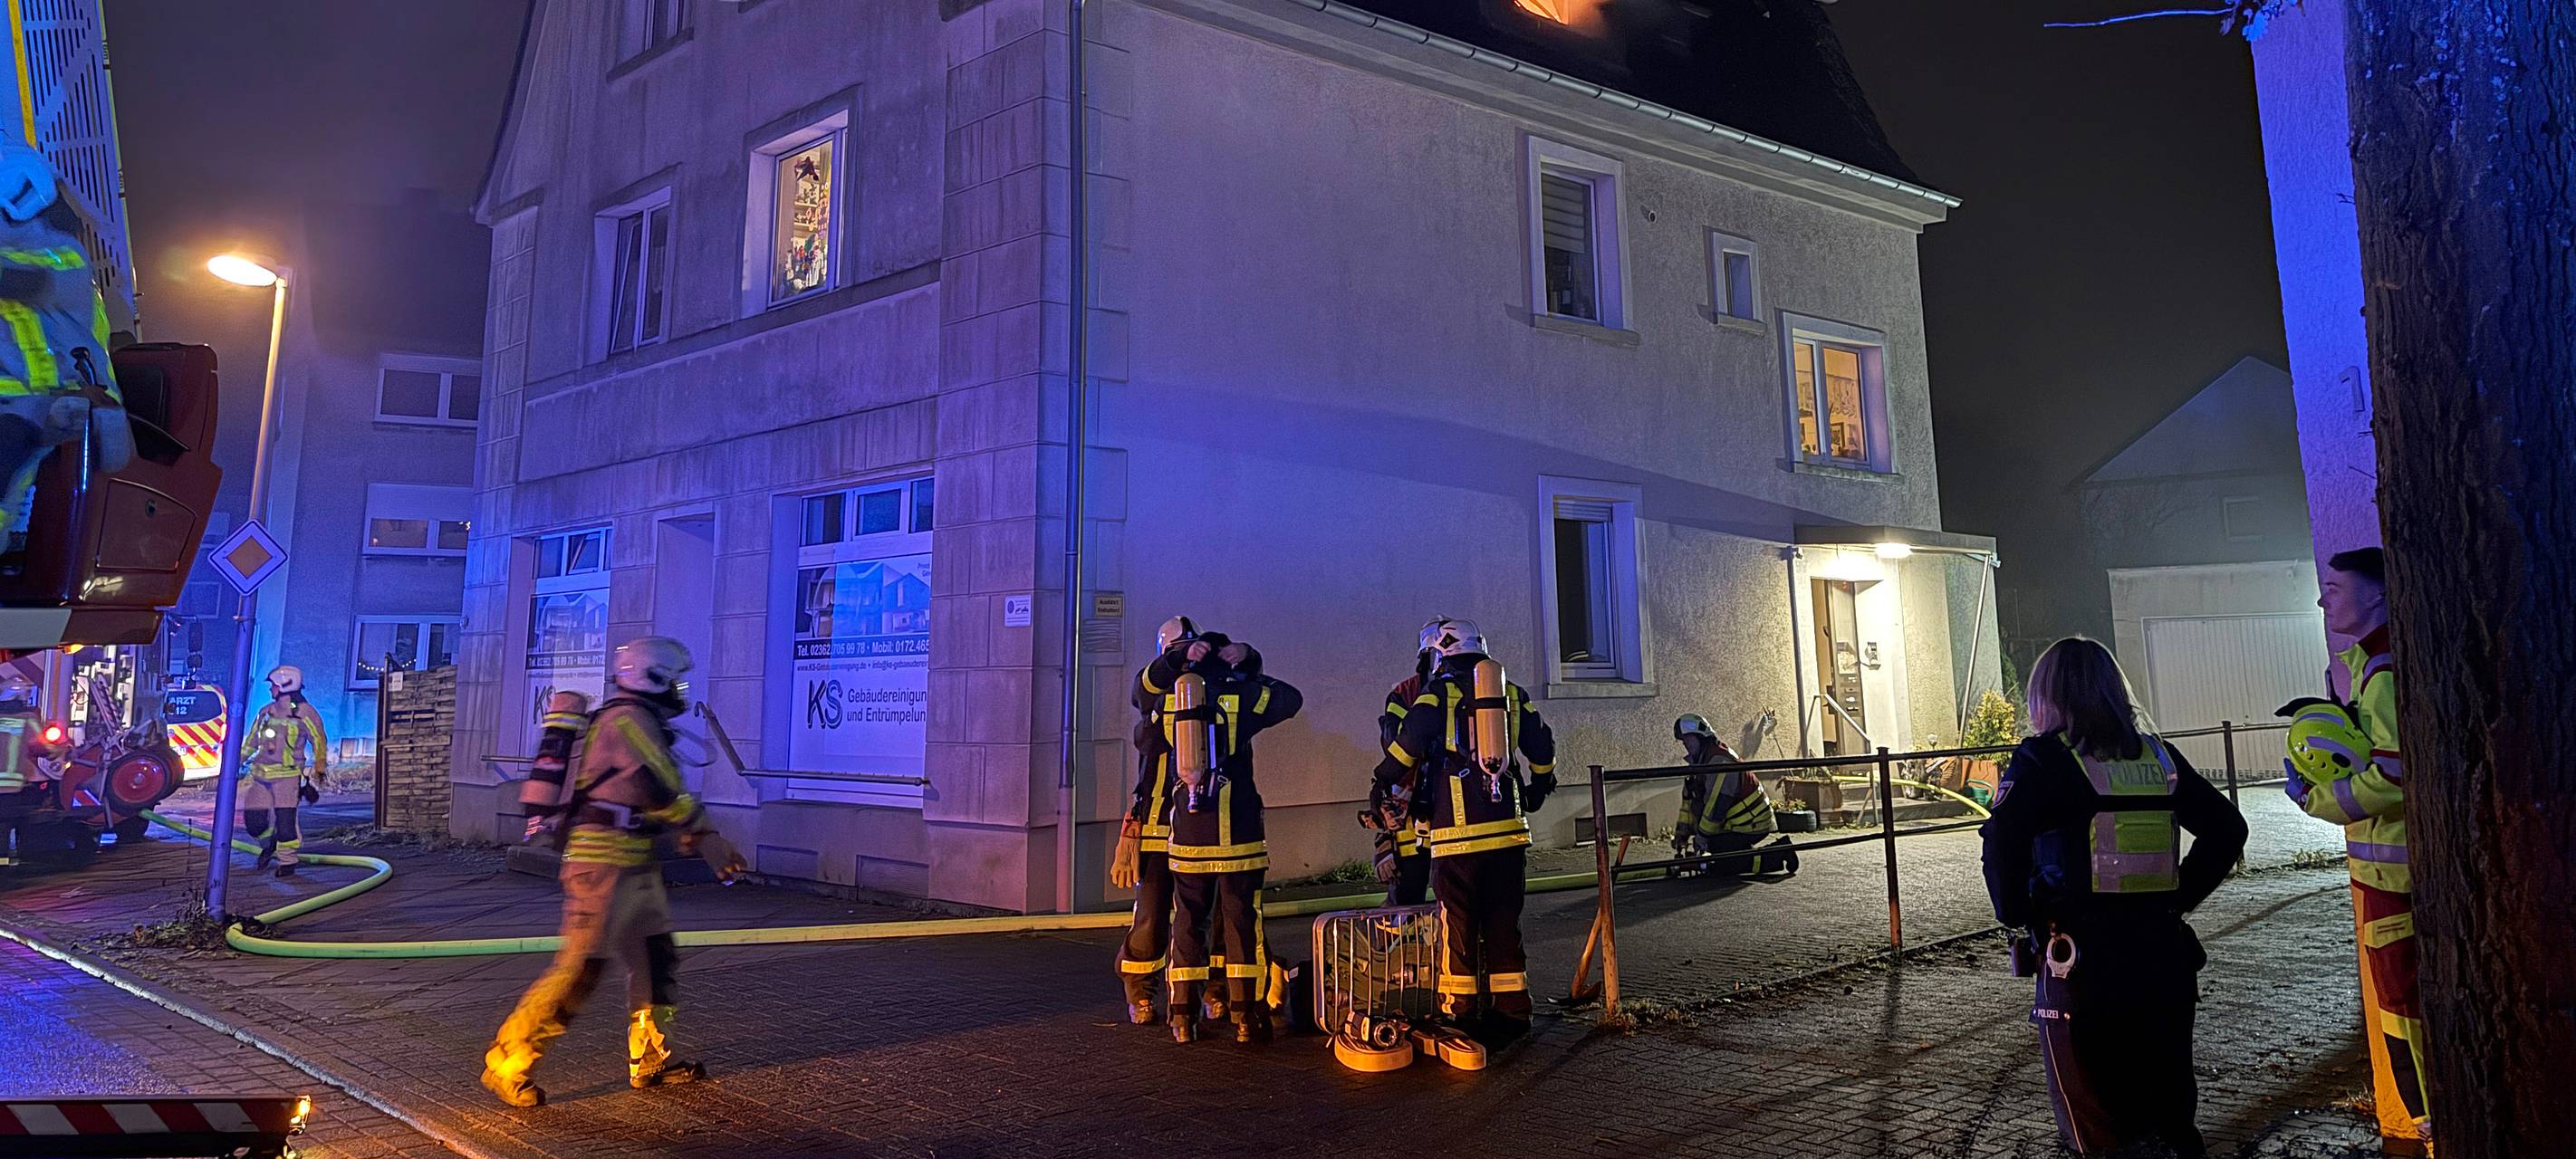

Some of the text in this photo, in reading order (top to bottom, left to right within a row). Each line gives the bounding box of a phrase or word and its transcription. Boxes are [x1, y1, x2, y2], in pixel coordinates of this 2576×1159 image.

[872, 639, 893, 653] Mobil:
[807, 679, 843, 730] KS
[848, 687, 927, 705] Gebäudereinigun
[847, 706, 926, 725] und Entrümpelun
[2106, 762, 2166, 787] POLIZEI
[2037, 1008, 2059, 1020] POLIZEI
